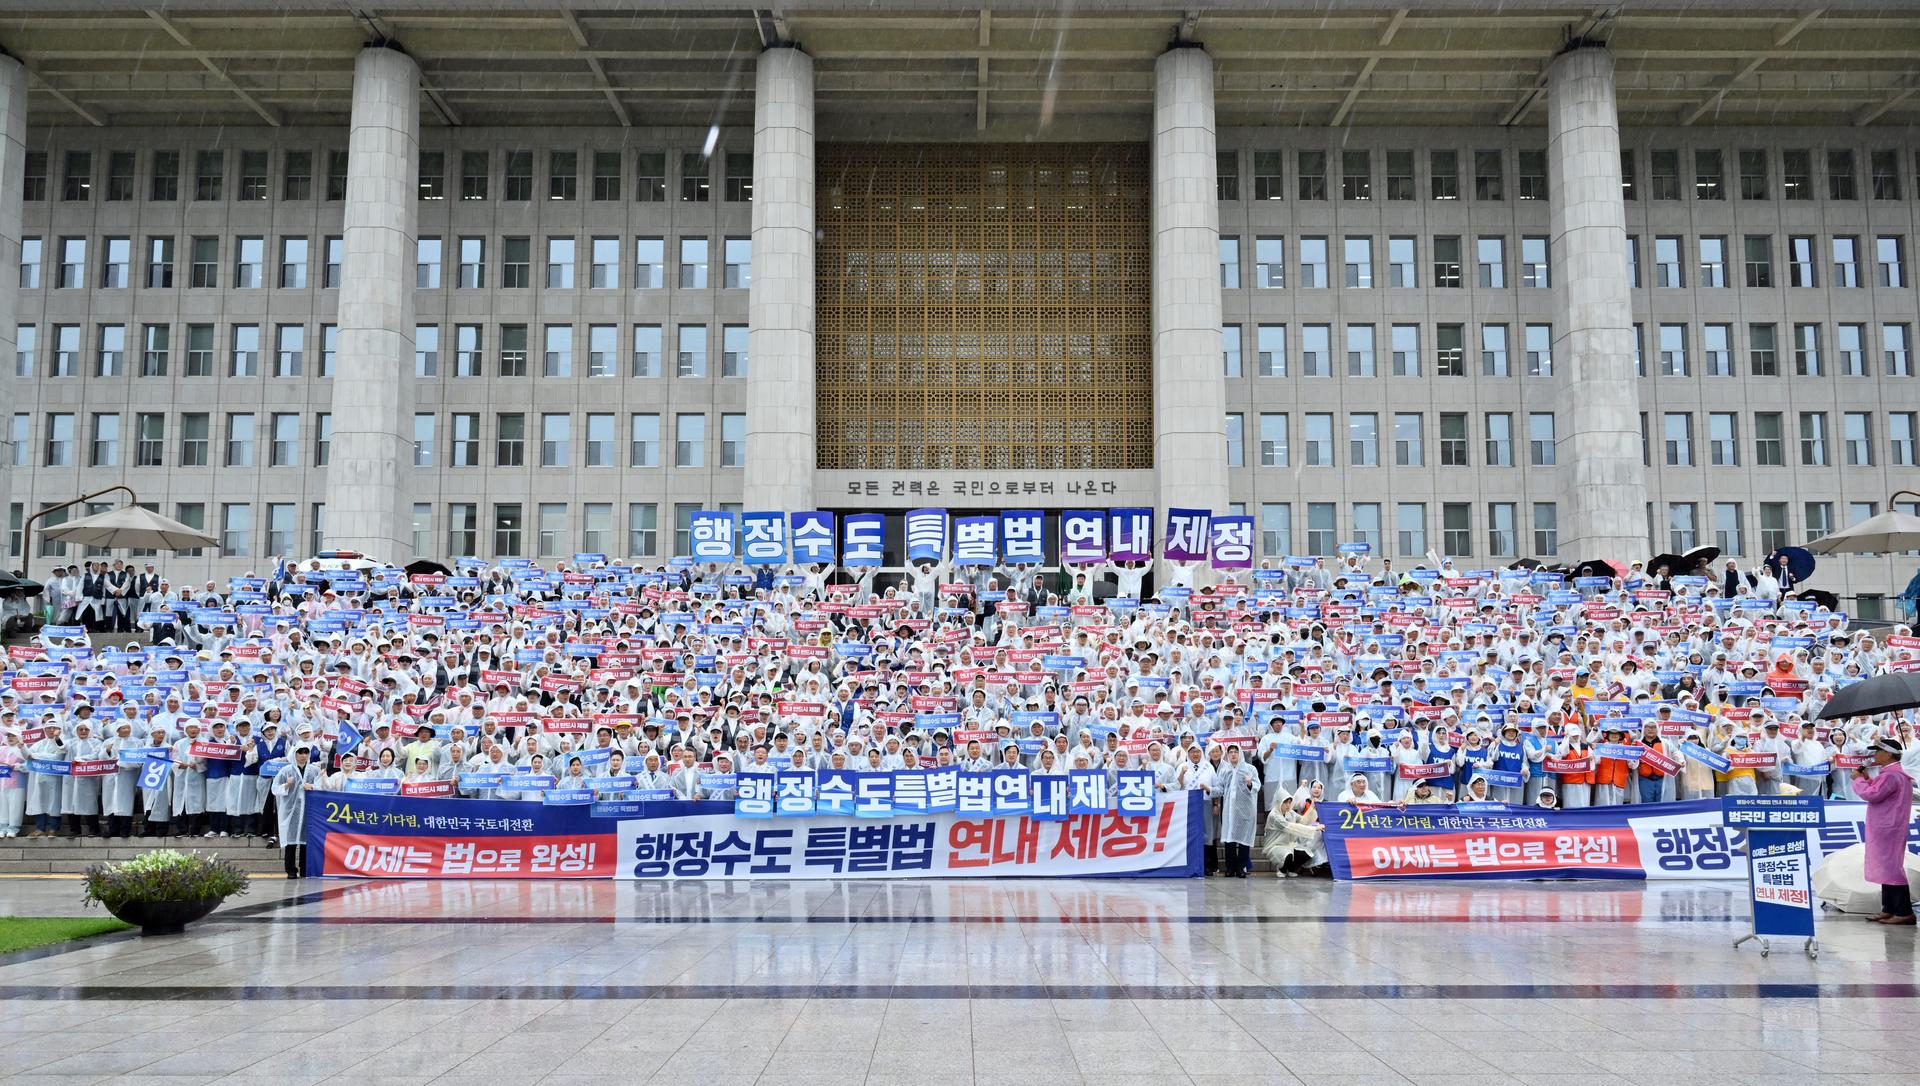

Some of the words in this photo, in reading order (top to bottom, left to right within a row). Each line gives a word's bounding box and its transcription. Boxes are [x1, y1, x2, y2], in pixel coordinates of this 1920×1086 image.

[848, 481, 879, 495] 모든
[892, 481, 940, 496] 권력은
[953, 480, 1054, 496] 국민으로부터
[1067, 480, 1117, 495] 나온다
[1500, 751, 1520, 760] YWCA
[326, 802, 378, 825] 24년간
[382, 814, 421, 828] 기다림,
[424, 816, 471, 831] 대한민국
[474, 817, 534, 832] 국토대전환
[1338, 809, 1393, 829] 24년간
[1396, 816, 1436, 829] 기다림,
[1438, 817, 1485, 829] 대한민국
[1488, 816, 1547, 829] 국토대전환
[1729, 811, 1765, 823] 범국민
[1769, 811, 1819, 823] 결의대회
[634, 829, 793, 878] 행정수도
[804, 822, 936, 873] 특별법
[948, 816, 1040, 868] 연내
[1371, 844, 1457, 870] 이제는
[1465, 836, 1546, 866] 법으로
[1554, 835, 1618, 864] 완성!
[1768, 844, 1785, 856] 법으로
[1787, 839, 1805, 853] 완성!
[343, 844, 431, 873] 이제는
[441, 843, 521, 874] 법으로
[530, 843, 596, 872] 완성!
[1757, 858, 1800, 872] 행정수도
[1762, 873, 1794, 886] 특별법
[1756, 887, 1775, 900] 연내
[1778, 889, 1808, 904] 제정!
